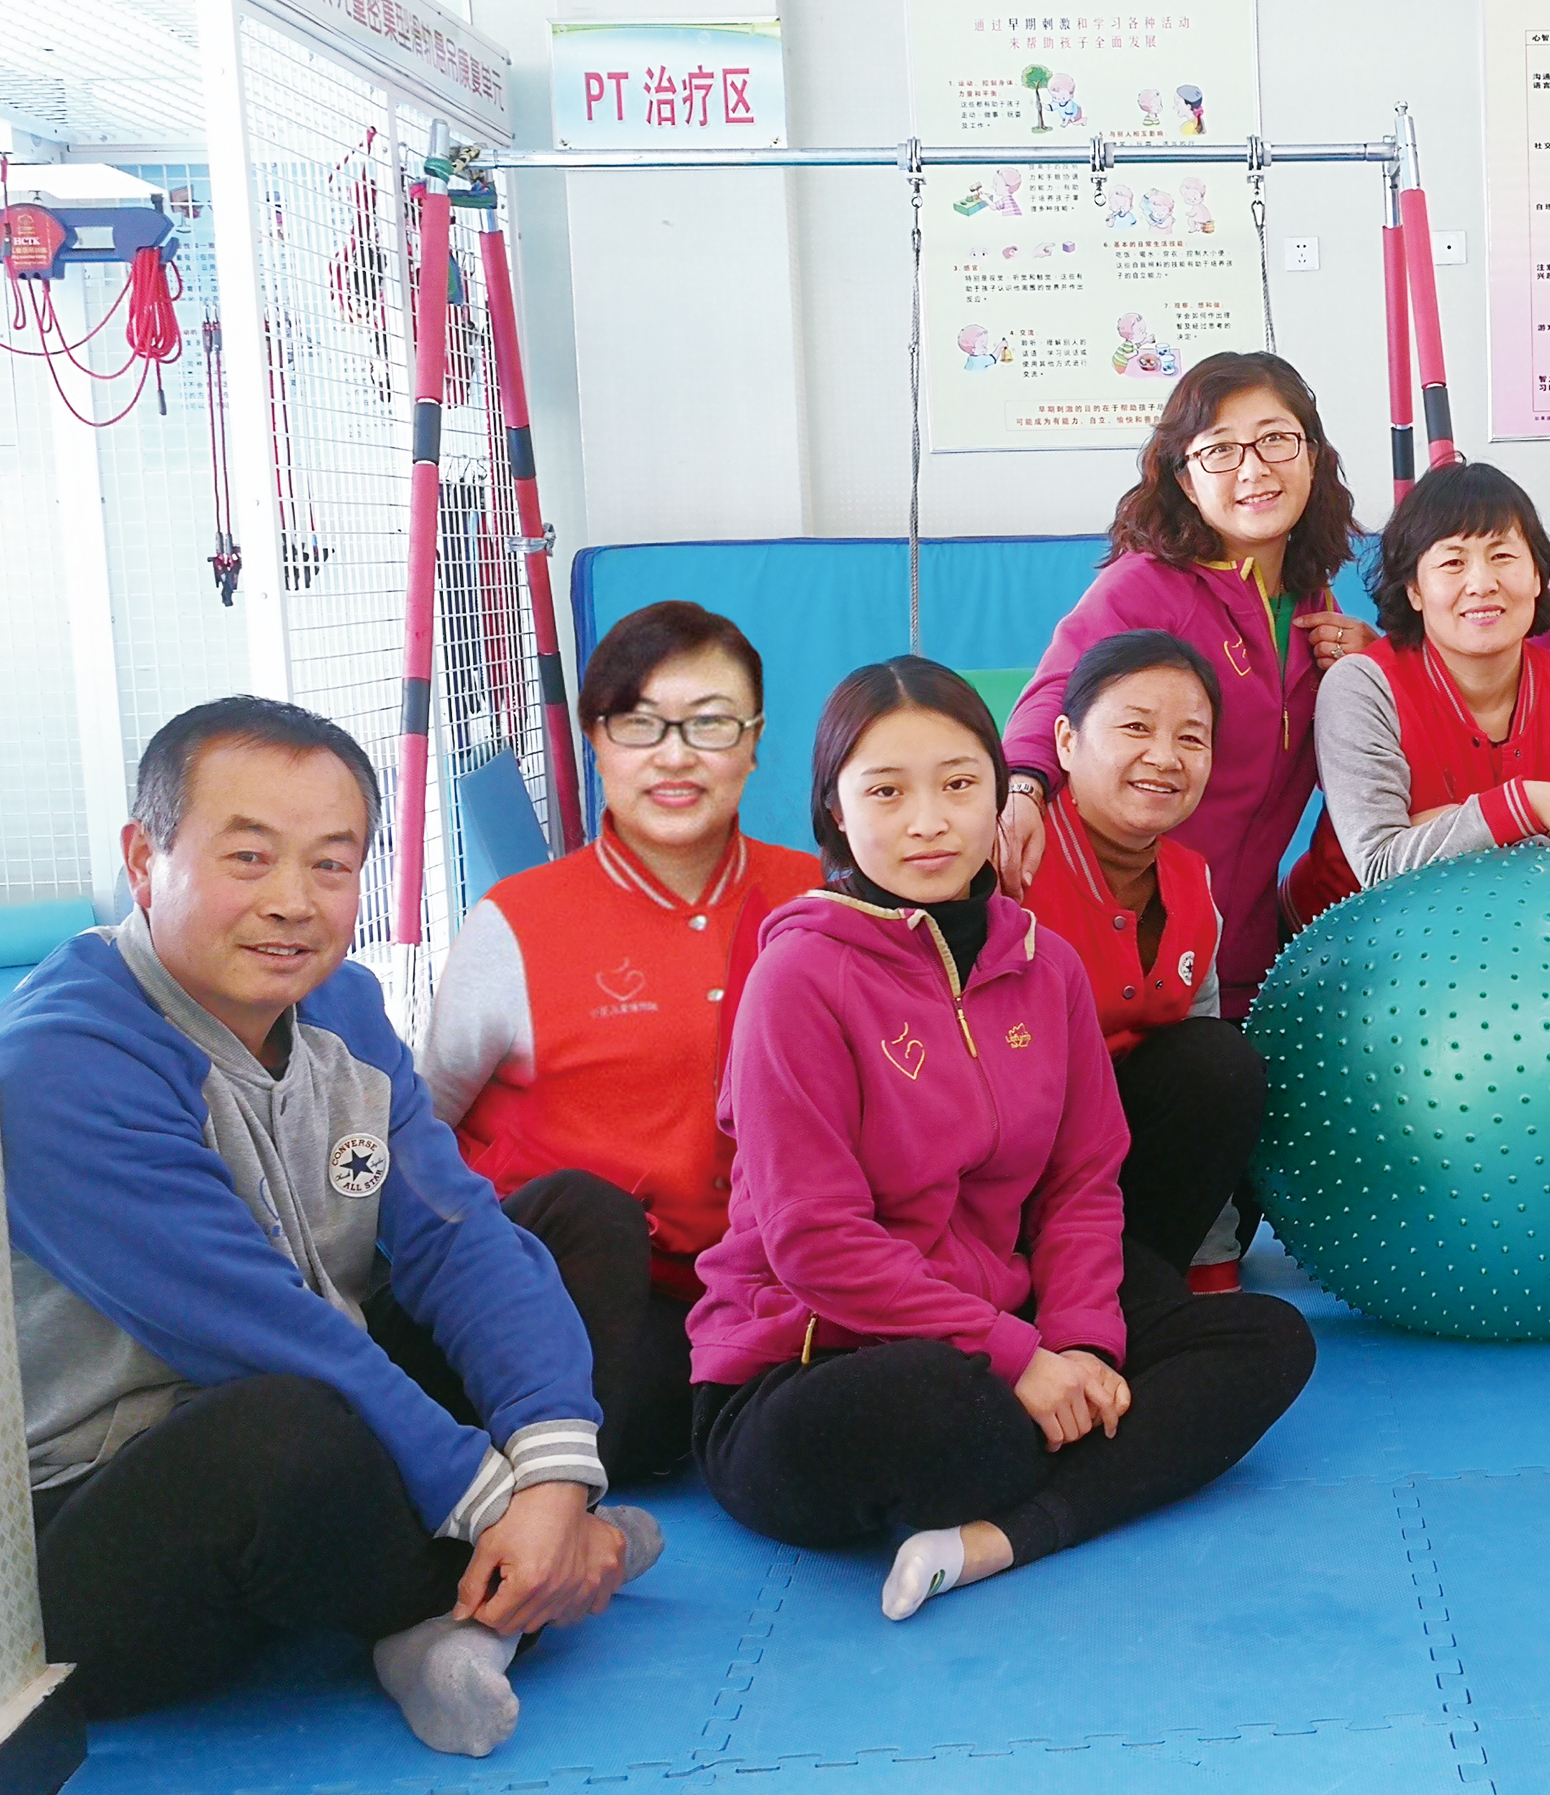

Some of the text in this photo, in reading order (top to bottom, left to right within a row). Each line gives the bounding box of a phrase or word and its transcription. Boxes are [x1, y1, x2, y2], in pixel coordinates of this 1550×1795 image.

[974, 16, 1190, 32] 通过早期刺激和学习各种活动
[1009, 35, 1157, 50] 来帮助孩子全面发展
[584, 64, 755, 127] PT 治疗区
[332, 1139, 378, 1167] CONVERSE
[342, 1182, 362, 1192] ALL
[364, 1169, 383, 1189] STAR
